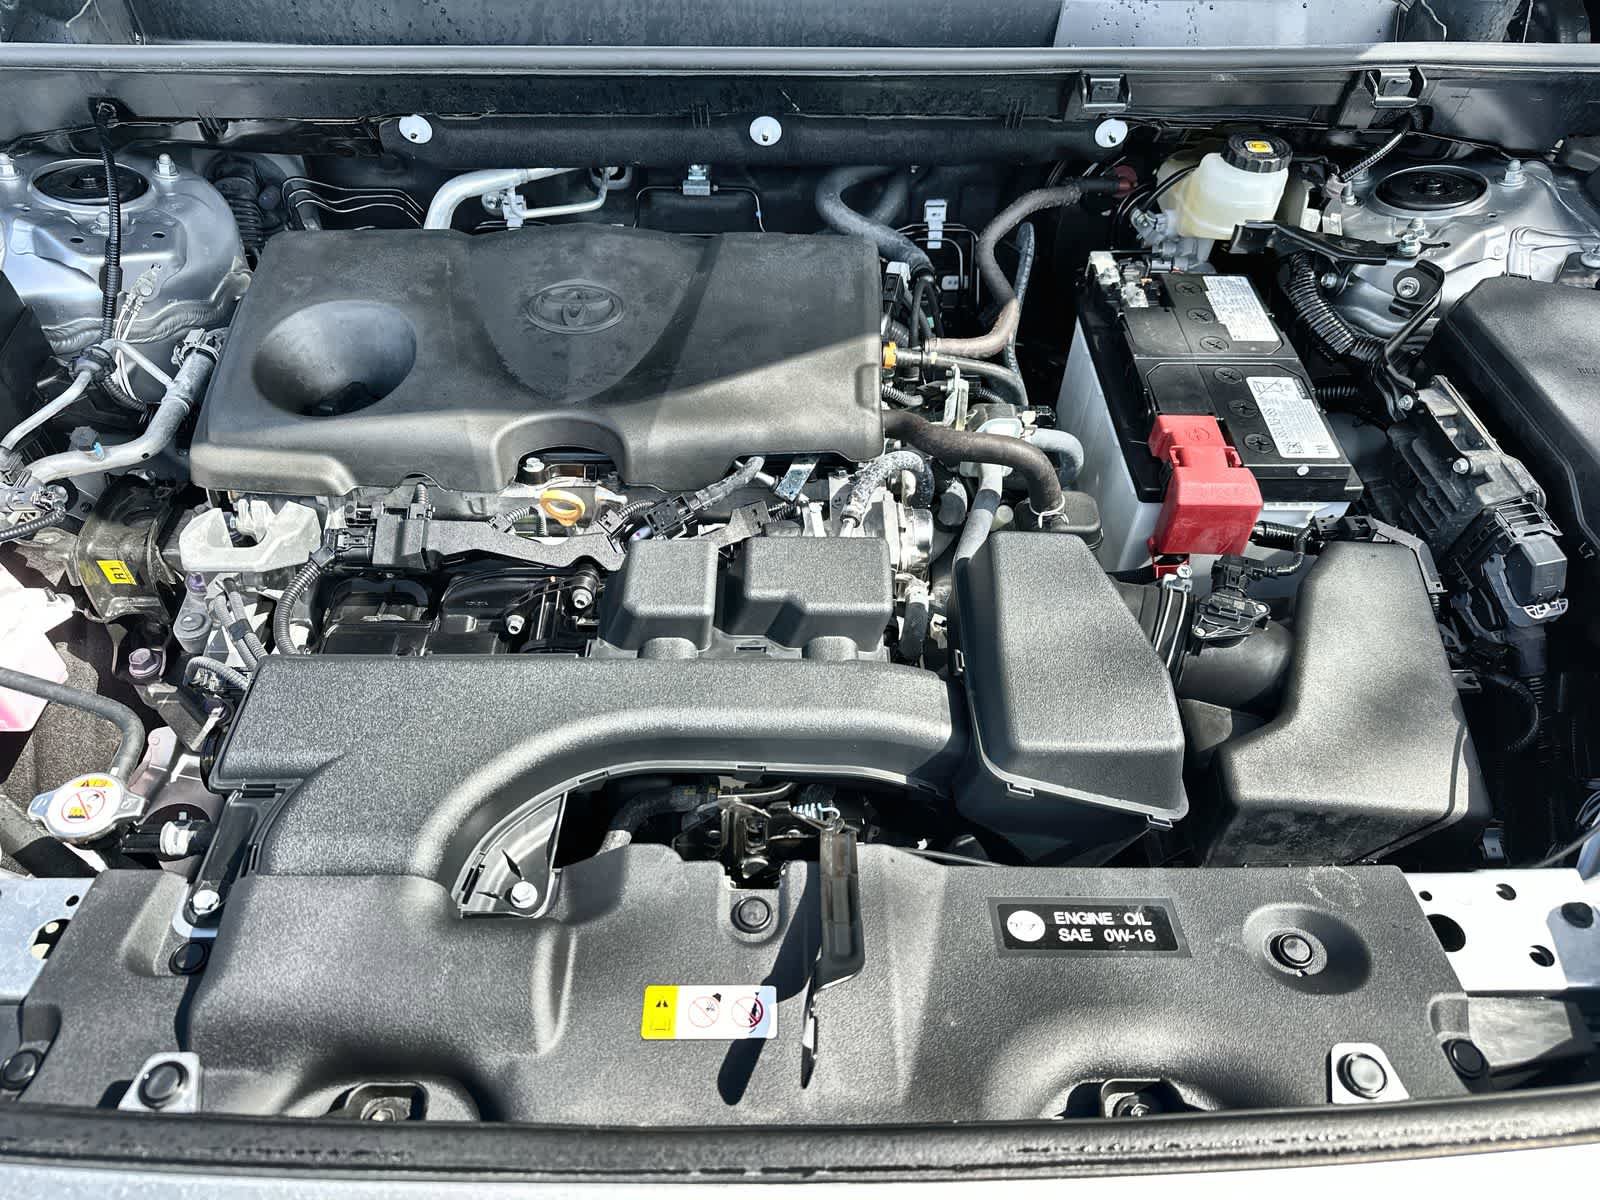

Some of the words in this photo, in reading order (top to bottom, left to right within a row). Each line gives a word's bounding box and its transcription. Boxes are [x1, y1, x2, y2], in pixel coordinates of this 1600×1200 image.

[110, 567, 127, 579] R1
[1053, 911, 1115, 926] ENGINE
[1123, 911, 1153, 926] OIL
[1058, 928, 1094, 942] SAE
[1103, 928, 1157, 943] 0W-16
